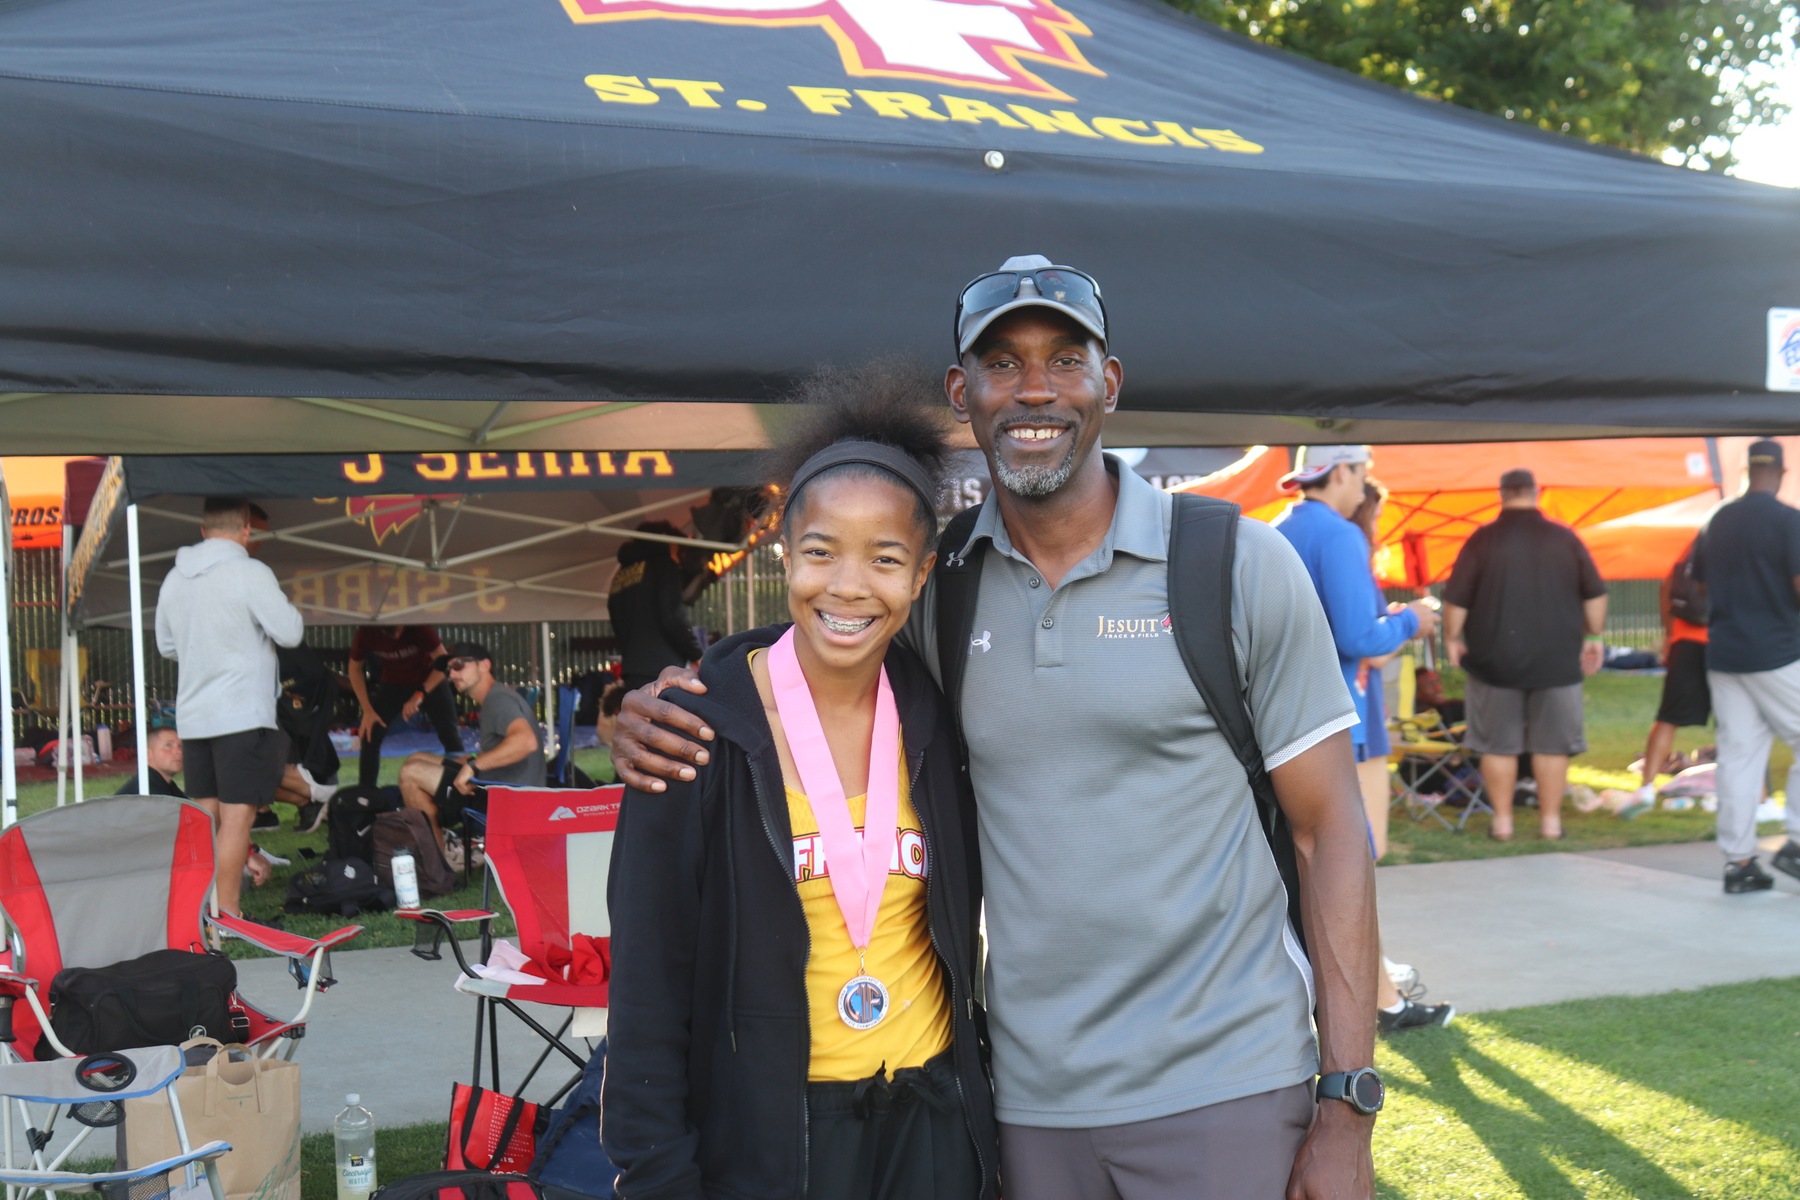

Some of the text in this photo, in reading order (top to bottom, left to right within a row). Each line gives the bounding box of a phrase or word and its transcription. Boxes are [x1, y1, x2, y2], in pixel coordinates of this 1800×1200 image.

[585, 74, 1264, 154] ST. FRANCIS
[11, 506, 62, 526] ROS
[348, 1177, 369, 1185] WATER
